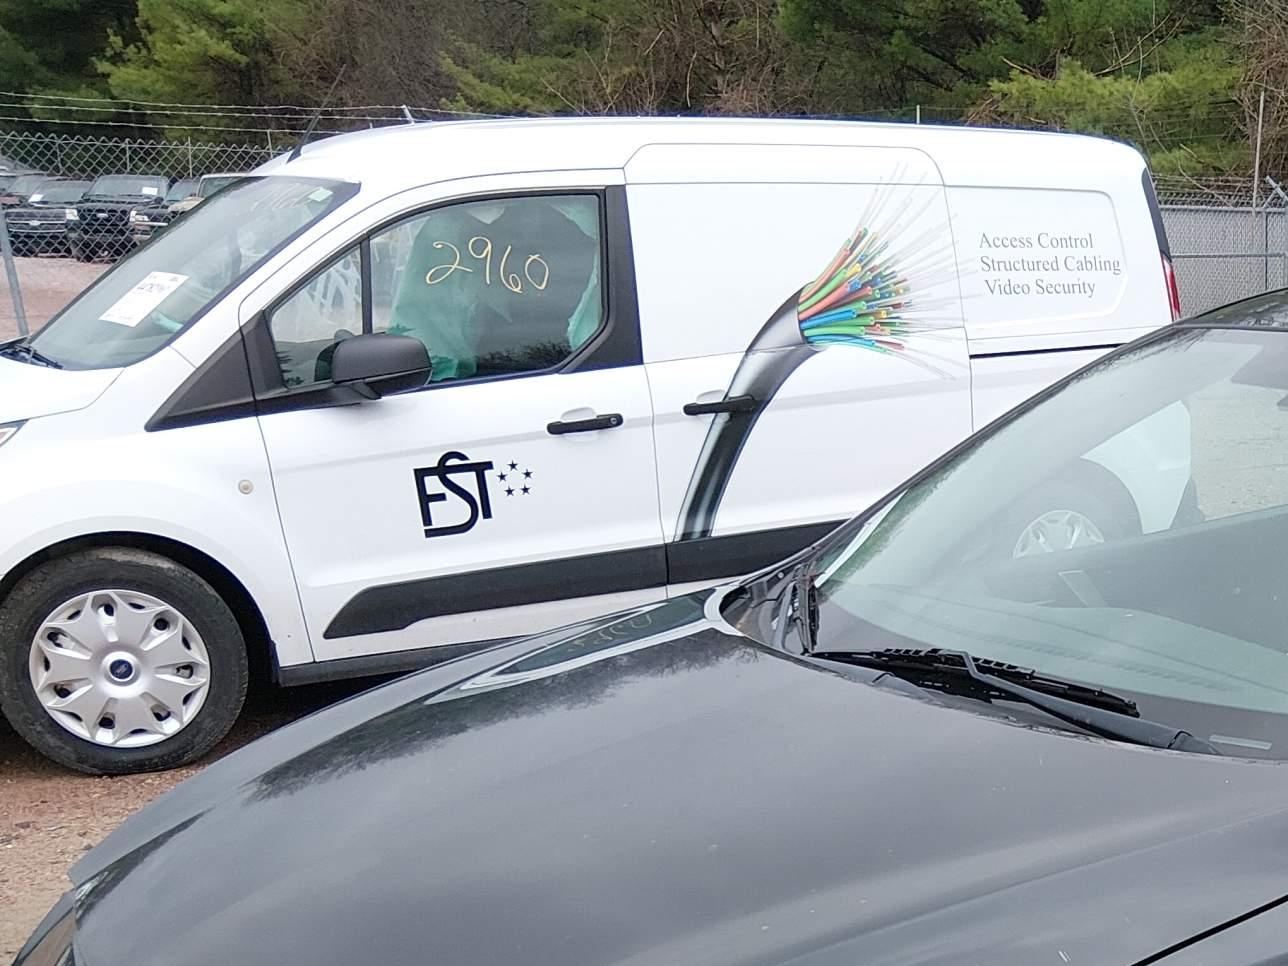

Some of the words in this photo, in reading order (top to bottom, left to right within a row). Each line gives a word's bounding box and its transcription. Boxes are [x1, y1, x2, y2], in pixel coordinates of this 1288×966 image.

[979, 232, 1033, 249] Access
[1037, 232, 1094, 249] Control
[426, 236, 549, 293] 2960
[980, 255, 1060, 272] Structured
[1063, 255, 1122, 276] Cabling
[984, 278, 1031, 296] Video
[1035, 278, 1096, 299] Security
